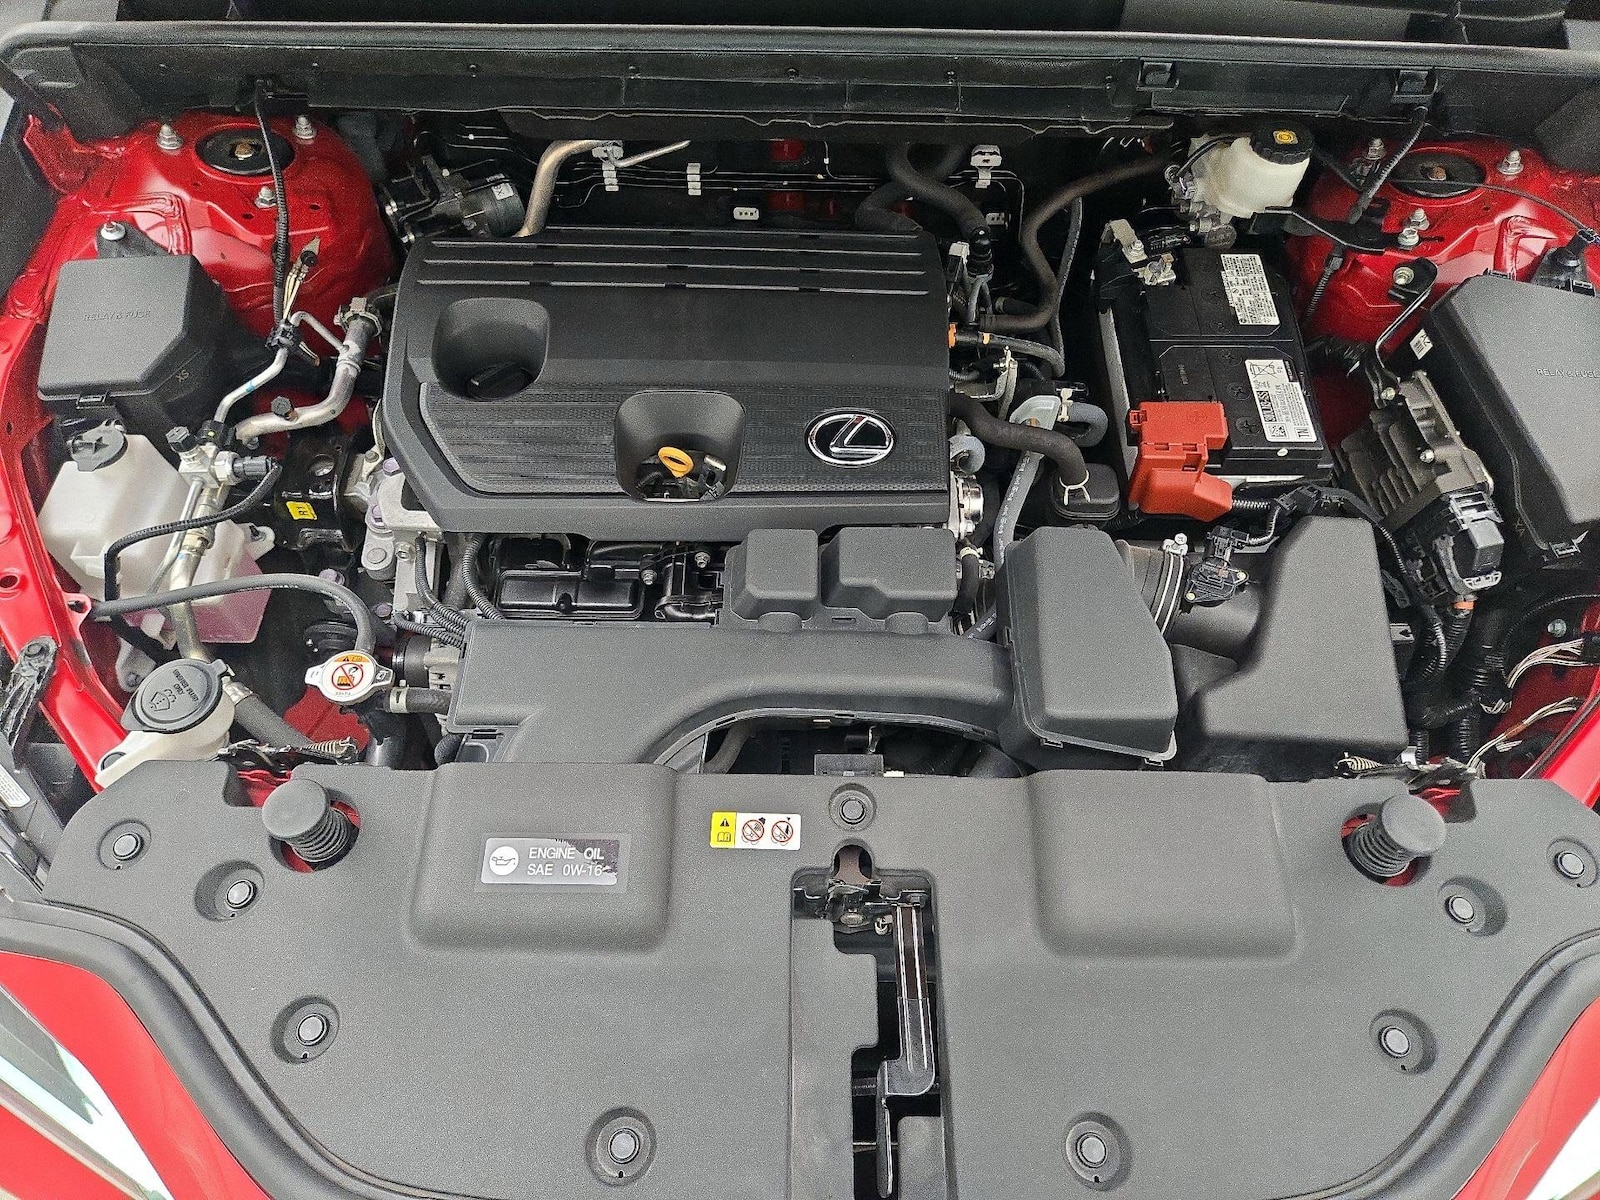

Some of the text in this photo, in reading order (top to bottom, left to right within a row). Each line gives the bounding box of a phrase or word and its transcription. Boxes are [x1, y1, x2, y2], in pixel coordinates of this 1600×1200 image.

[1535, 368, 1564, 378] RELAY
[528, 847, 605, 860] ENGINE OIL
[527, 863, 603, 877] SAE 0W-16
